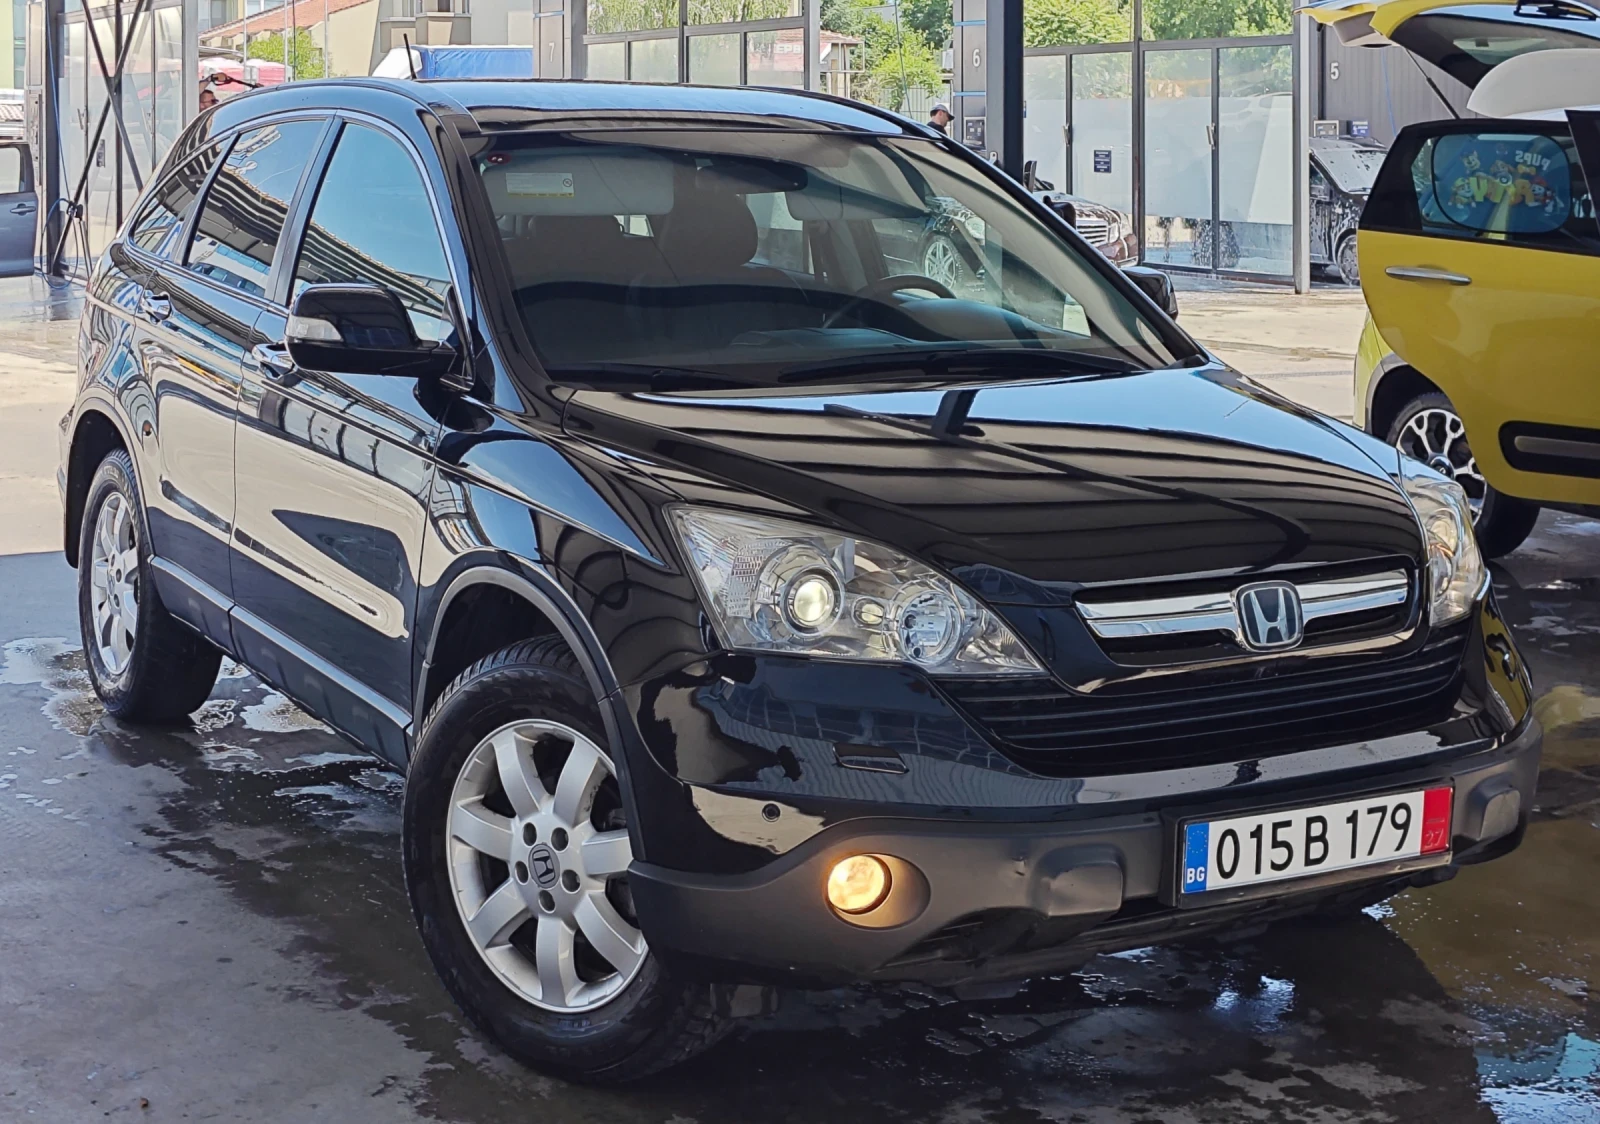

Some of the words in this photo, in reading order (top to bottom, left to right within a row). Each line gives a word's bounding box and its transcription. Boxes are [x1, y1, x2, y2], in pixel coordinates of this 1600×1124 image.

[548, 42, 555, 62] 7
[972, 48, 981, 67] 6
[1330, 62, 1339, 80] 5
[1346, 802, 1412, 859] 179
[1187, 866, 1205, 884] BG
